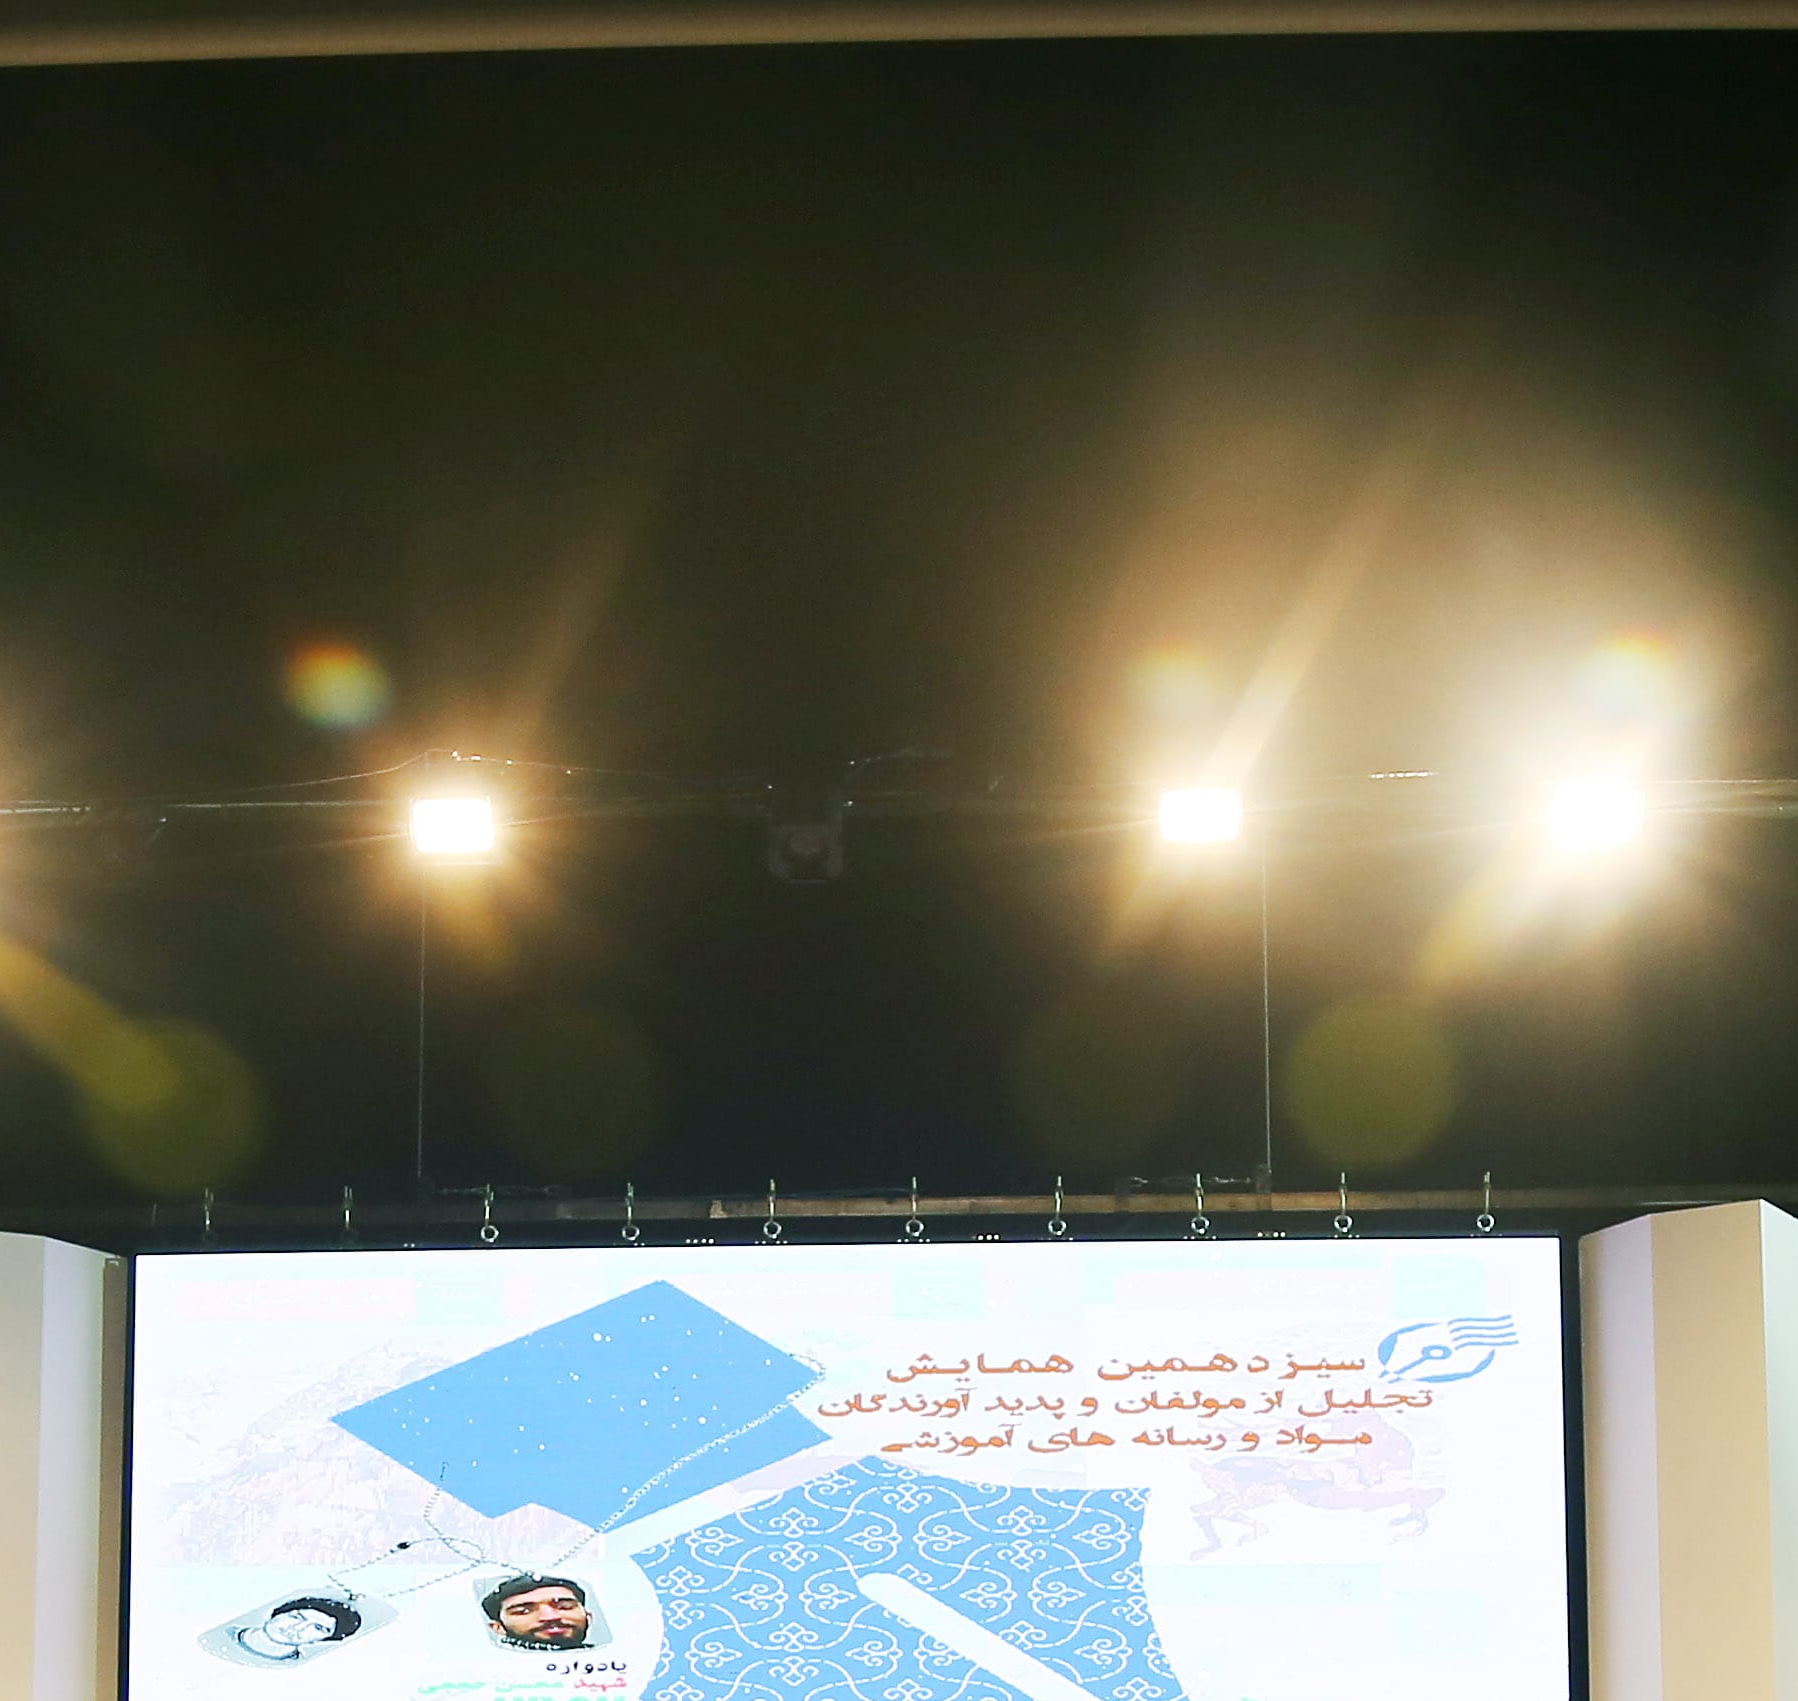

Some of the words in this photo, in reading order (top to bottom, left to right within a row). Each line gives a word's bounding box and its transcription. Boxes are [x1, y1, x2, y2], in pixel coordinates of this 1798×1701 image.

[886, 1352, 1075, 1384] همایش
[817, 1387, 978, 1418] آورندگان
[984, 1394, 1065, 1420] پدید
[1075, 1396, 1099, 1417] و
[1113, 1389, 1247, 1419] مولفان
[1253, 1389, 1285, 1415] از
[1297, 1387, 1434, 1418] تجلیل
[880, 1423, 1023, 1457] آموزشی
[1027, 1426, 1117, 1454] های
[1131, 1426, 1228, 1451] رسانه
[1236, 1430, 1261, 1452] و
[1275, 1424, 1373, 1454] مواد
[545, 1660, 627, 1675] یادواره
[494, 1680, 564, 1693] محسن
[573, 1676, 628, 1692] شهید
